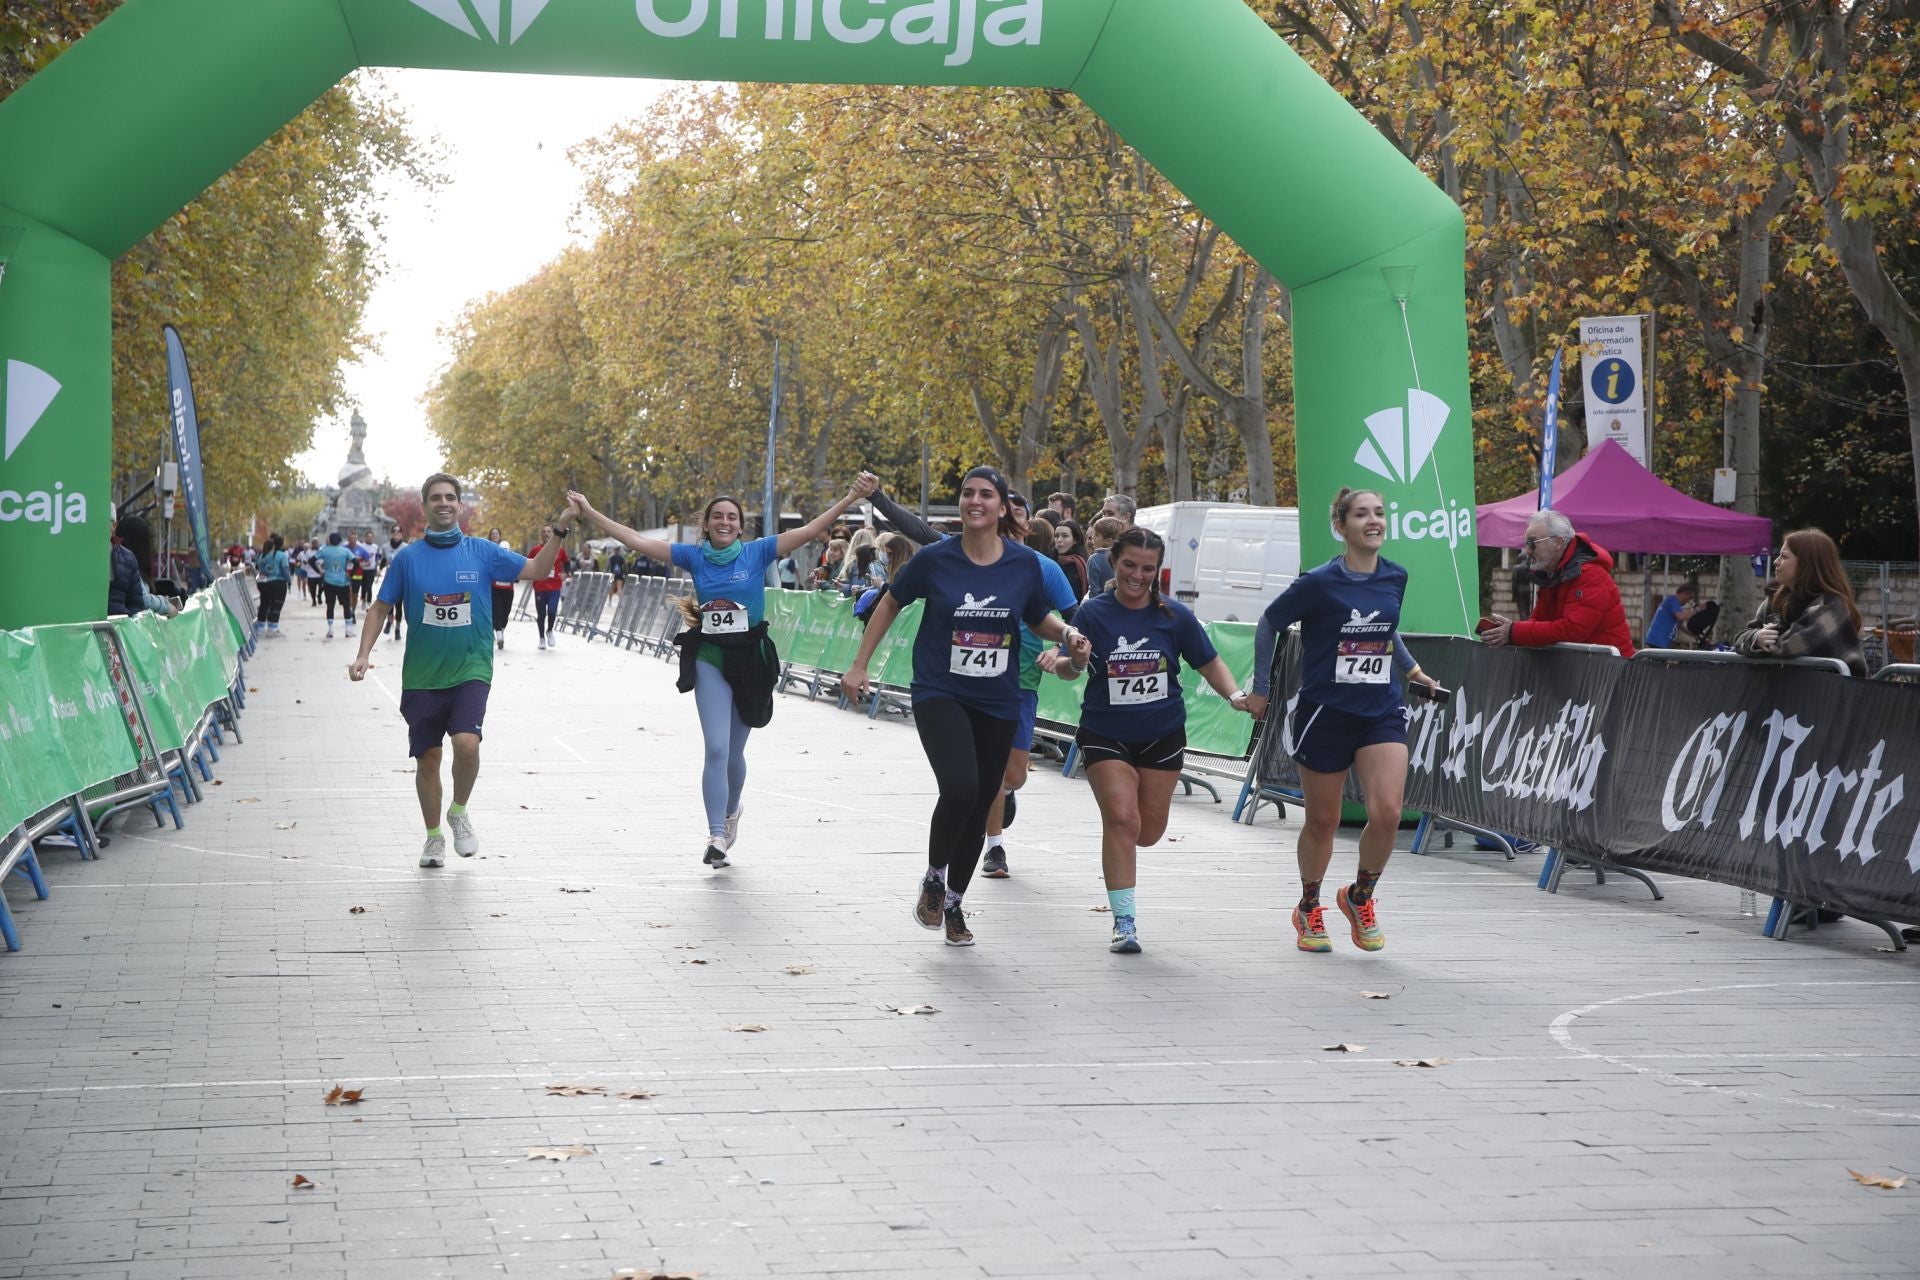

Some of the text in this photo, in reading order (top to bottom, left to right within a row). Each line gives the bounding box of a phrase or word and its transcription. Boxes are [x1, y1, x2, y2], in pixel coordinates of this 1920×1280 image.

[1587, 325, 1625, 335] Oficina de
[1596, 348, 1622, 356] rstica
[1330, 498, 1472, 550] icaja
[435, 606, 458, 620] 96
[711, 611, 734, 627] 94
[953, 610, 1010, 618] MICHELIN
[1340, 625, 1390, 633] MICHELIN
[959, 648, 998, 668] 741
[1108, 652, 1160, 661] MICHELIN
[1345, 657, 1383, 675] 740
[1117, 676, 1159, 696] 742
[1661, 710, 1748, 833] El
[1738, 708, 1904, 867] Norte
